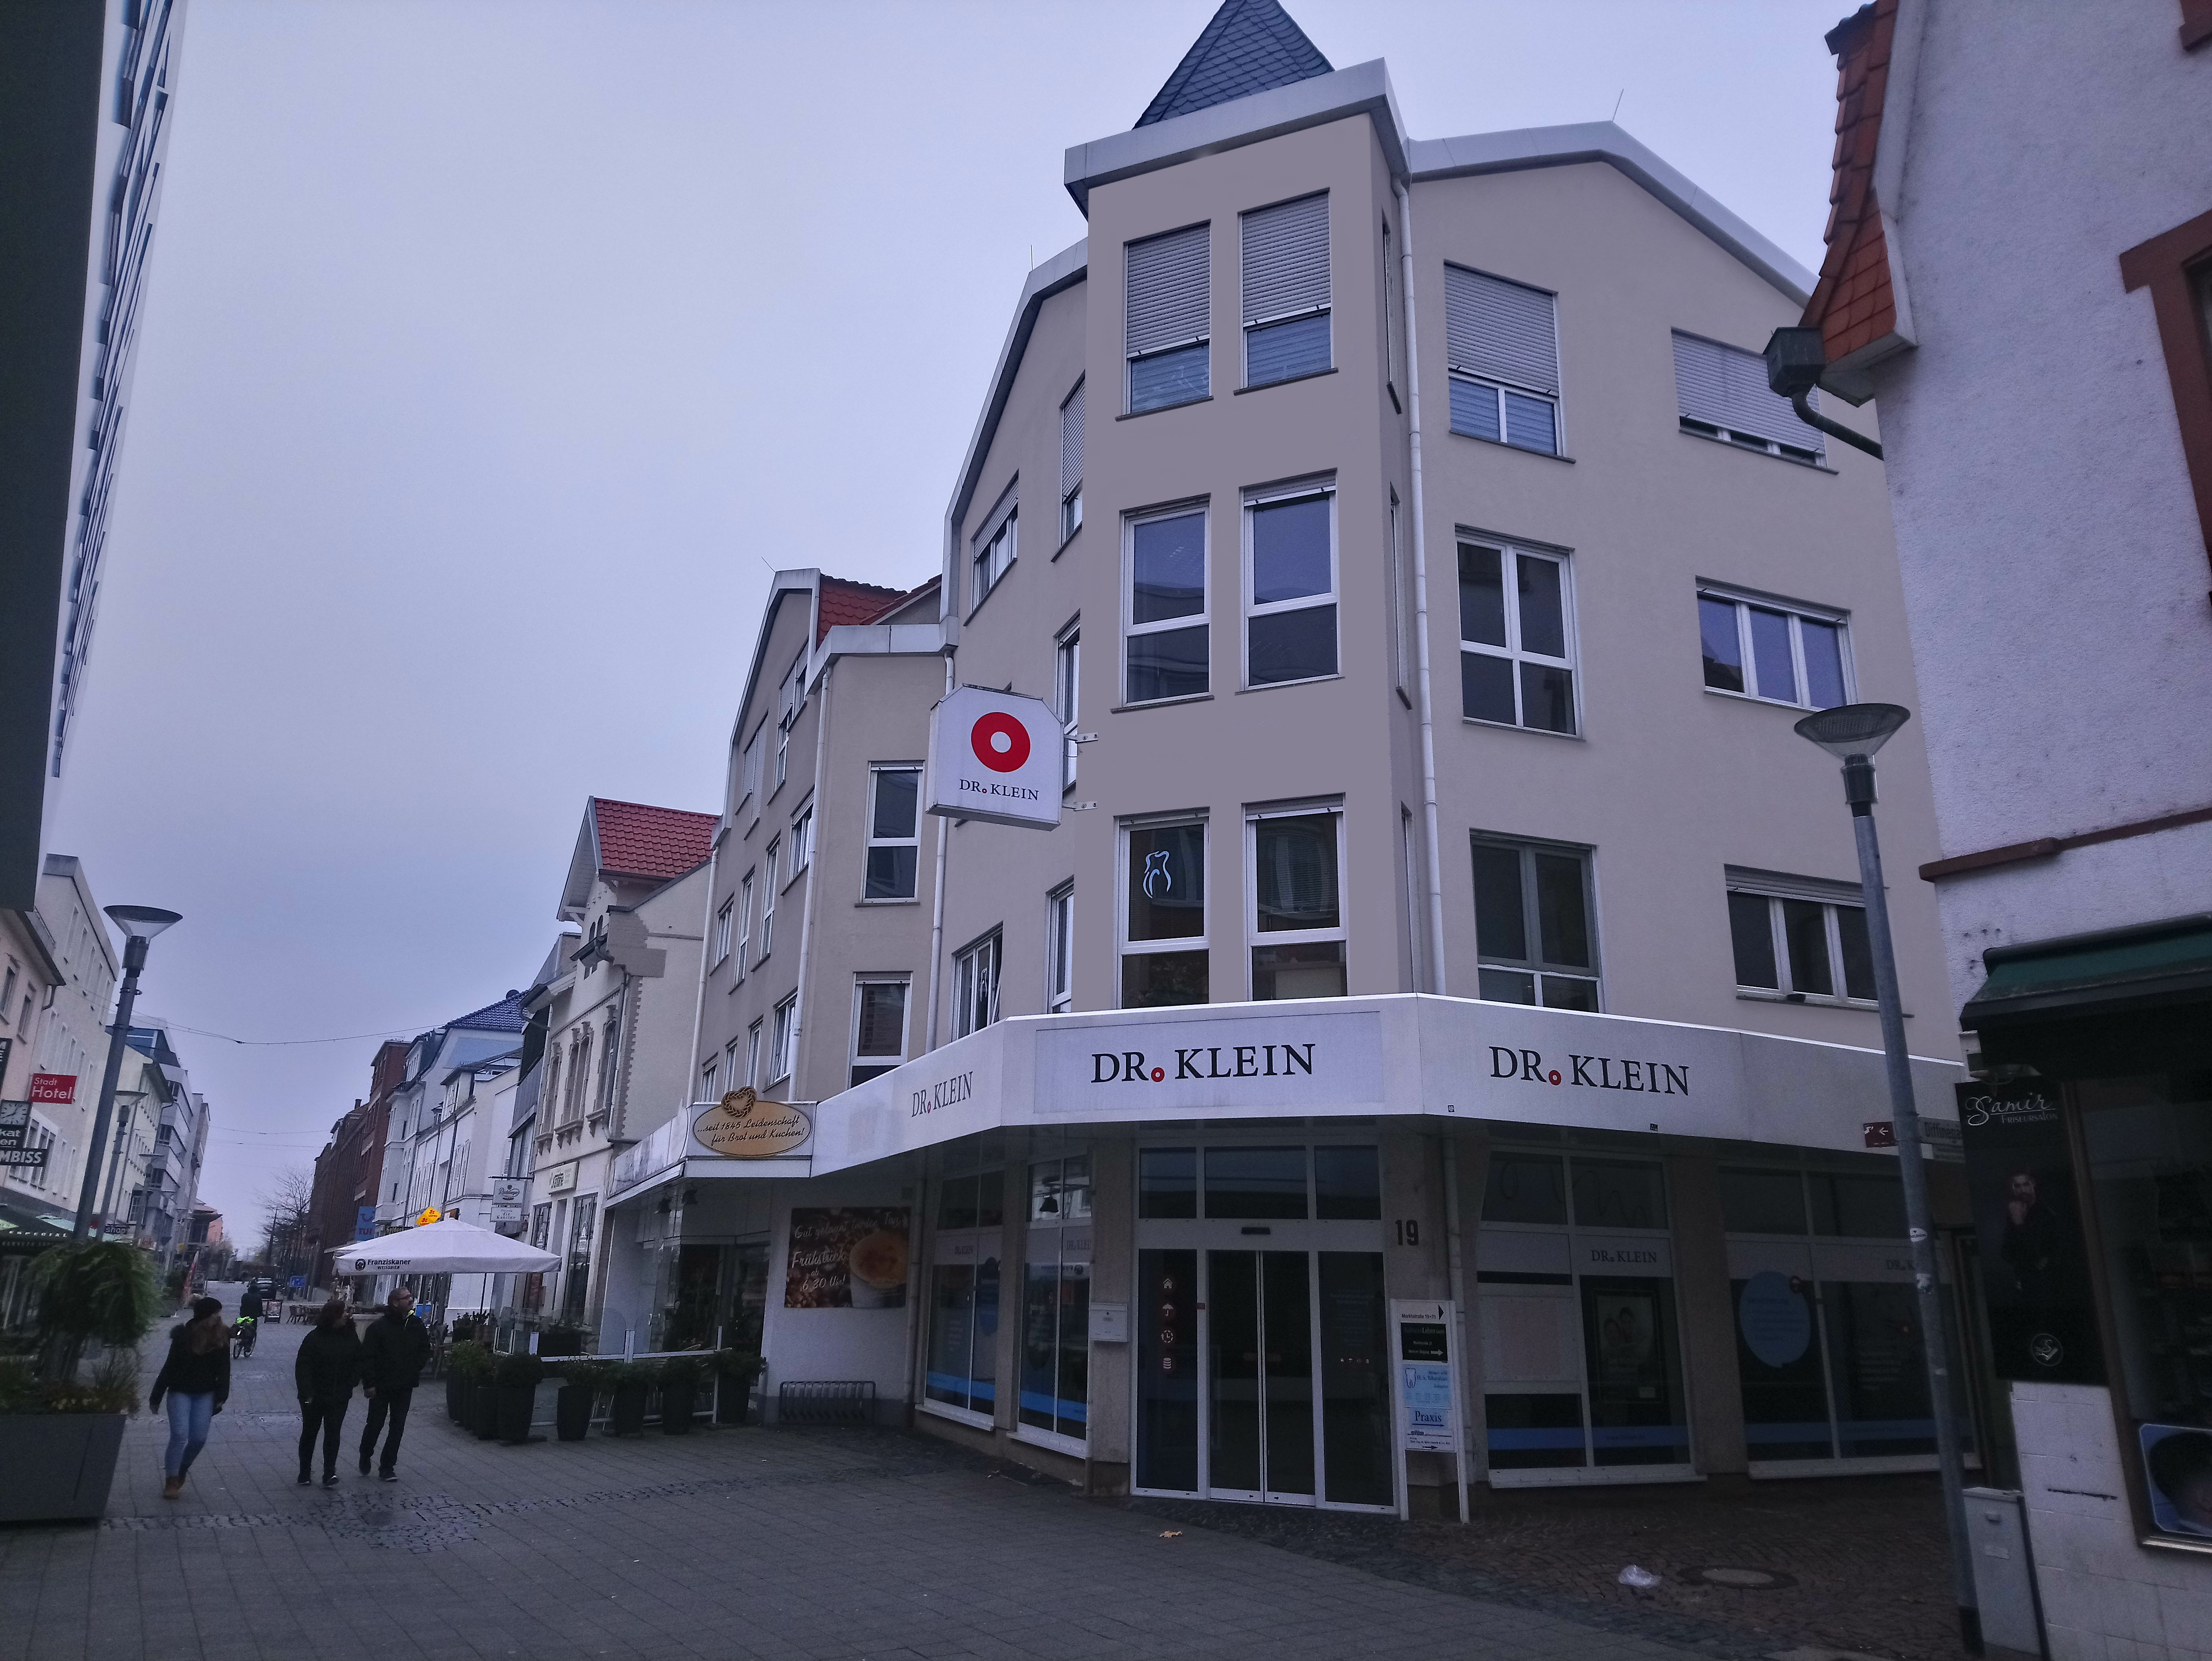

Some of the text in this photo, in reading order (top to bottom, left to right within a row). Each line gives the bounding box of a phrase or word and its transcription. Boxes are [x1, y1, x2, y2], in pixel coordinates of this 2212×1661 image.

[991, 783, 1039, 800] KLEIN
[1175, 1043, 1316, 1079] KLEIN
[34, 1077, 57, 1085] Stadt
[1569, 1054, 1689, 1096] KLEIN
[32, 1085, 72, 1099] Hotel
[933, 1071, 973, 1110] KLEIN
[1965, 1092, 2053, 1126] Samir
[721, 1121, 741, 1130] 1845
[744, 1114, 800, 1128] Leidenschaft
[711, 1127, 805, 1146] für Brot und Kuchen!
[1395, 1219, 1419, 1246] 19
[1617, 1251, 1657, 1263] KLEIN
[811, 1267, 819, 1276] ab
[1415, 1410, 1442, 1422] Praxis
